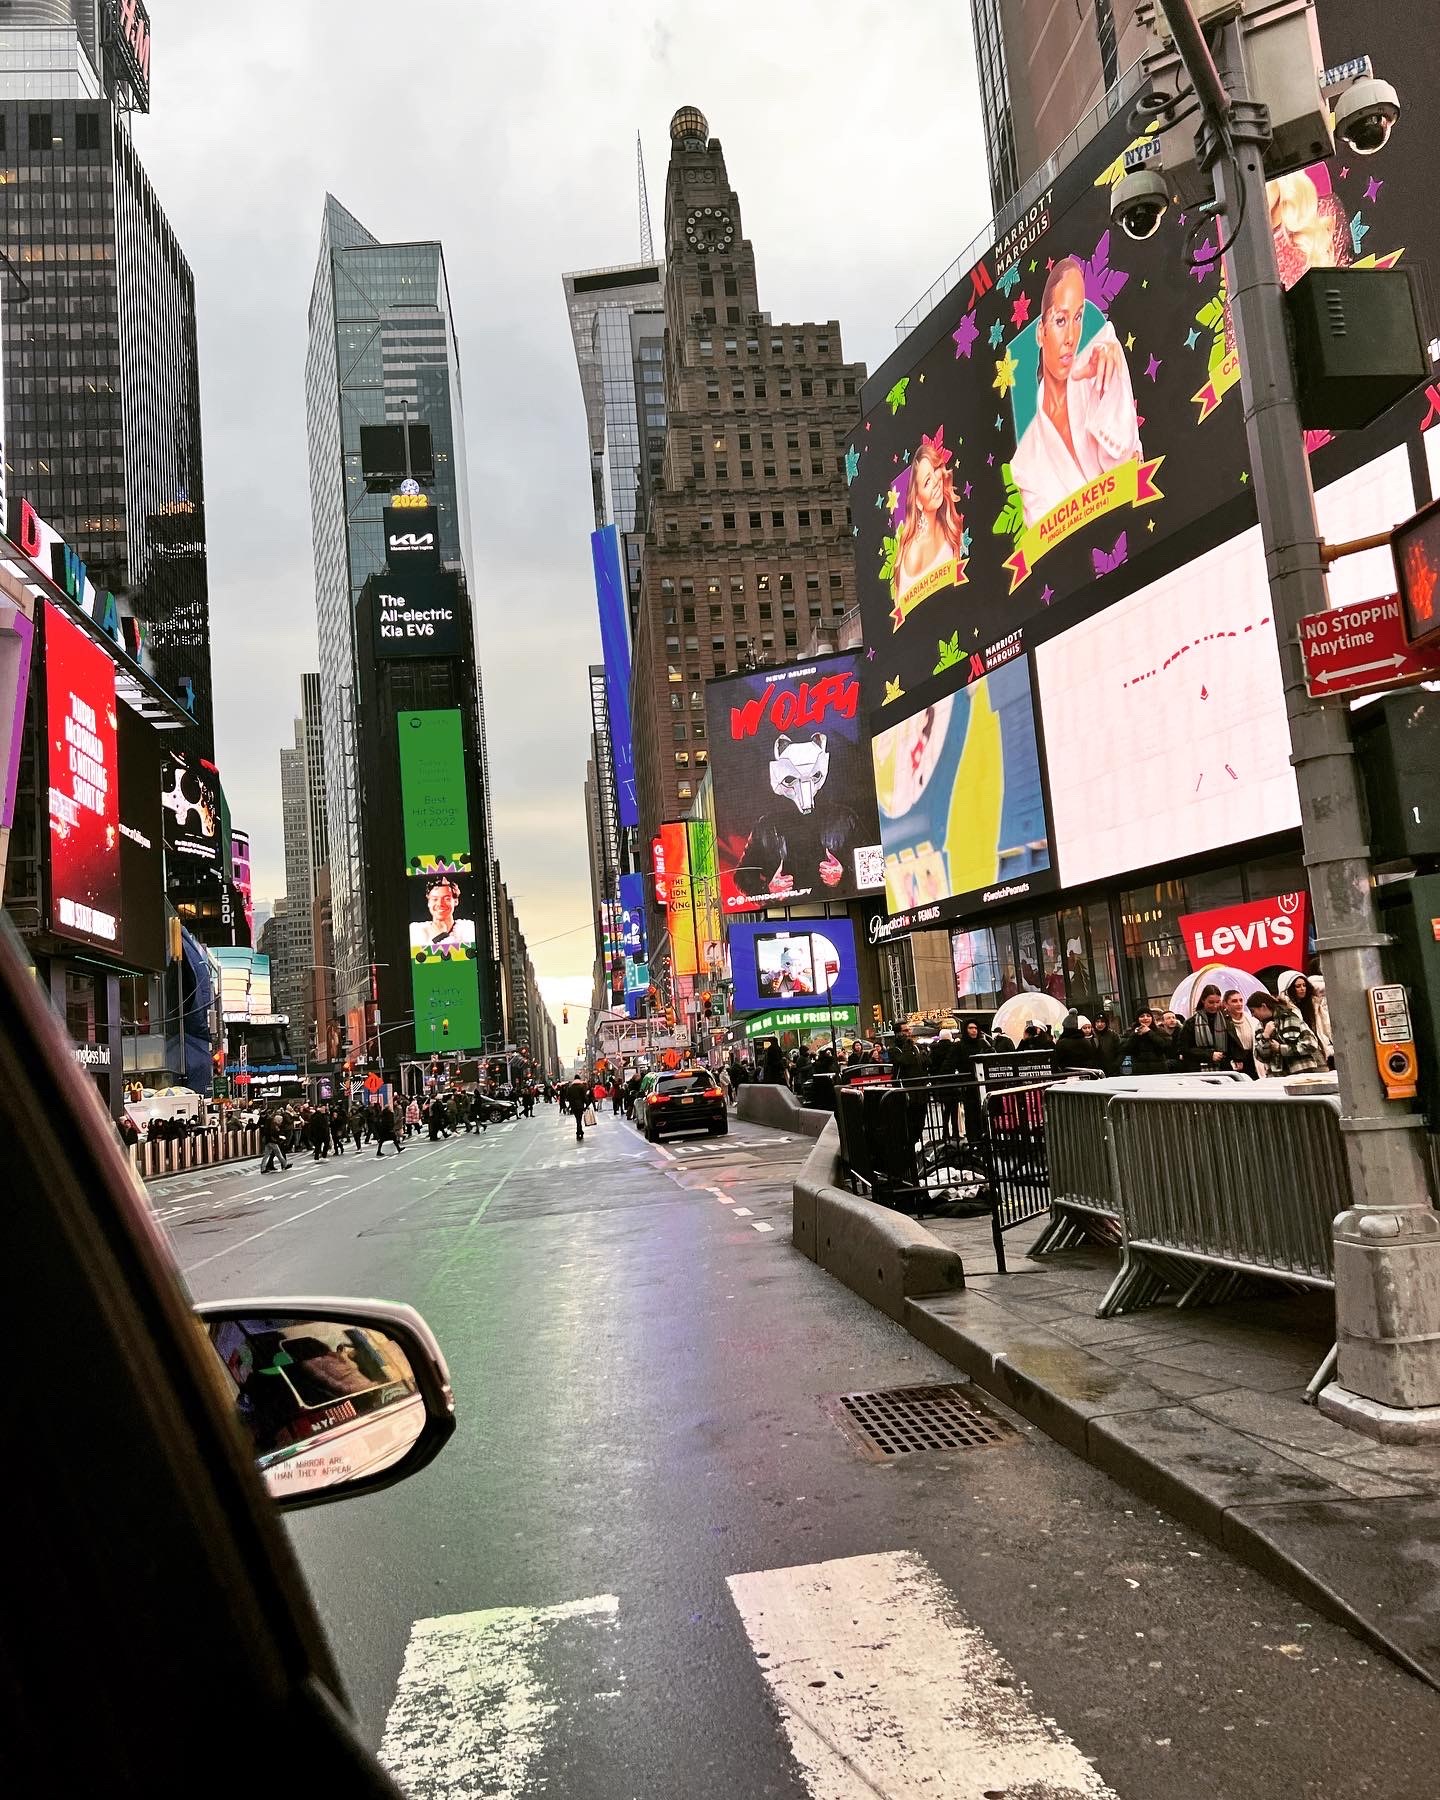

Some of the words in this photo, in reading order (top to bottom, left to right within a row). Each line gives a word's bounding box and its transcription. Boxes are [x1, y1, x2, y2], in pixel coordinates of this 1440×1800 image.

[1325, 56, 1367, 85] NYPD
[1124, 138, 1161, 165] NYPD
[995, 188, 1053, 259] MARRIOTT
[996, 215, 1048, 276] MARQUIS
[391, 493, 428, 508] 2022
[1039, 499, 1079, 540] ALICIA
[1081, 476, 1116, 508] KEYS
[903, 578, 928, 604] MARIAH
[929, 564, 951, 584] CAREY
[379, 595, 405, 607] The
[380, 608, 453, 622] All-electric
[1306, 621, 1328, 640] NO
[1331, 602, 1399, 633] STOPPIN
[381, 624, 404, 637] Kia
[406, 623, 435, 636] EV6
[985, 627, 1023, 657] MARRIOTT
[1310, 631, 1375, 657] Anytime
[986, 643, 1020, 669] MARQUIS
[765, 673, 787, 683] NEW
[788, 667, 817, 679] MUSIC
[670, 888, 687, 899] LION
[983, 883, 1030, 903] #SwatchPeanuts
[221, 884, 231, 924] 1500
[669, 901, 690, 912] KING
[917, 906, 940, 922] PEANUTS
[776, 1013, 801, 1025] LINE
[803, 1010, 849, 1024] FRIENDS
[676, 1033, 687, 1041] 25
[99, 1045, 111, 1065] hut
[296, 1457, 325, 1468] MIRROR
[274, 1471, 293, 1480] THAN
[299, 1469, 317, 1479] THEY
